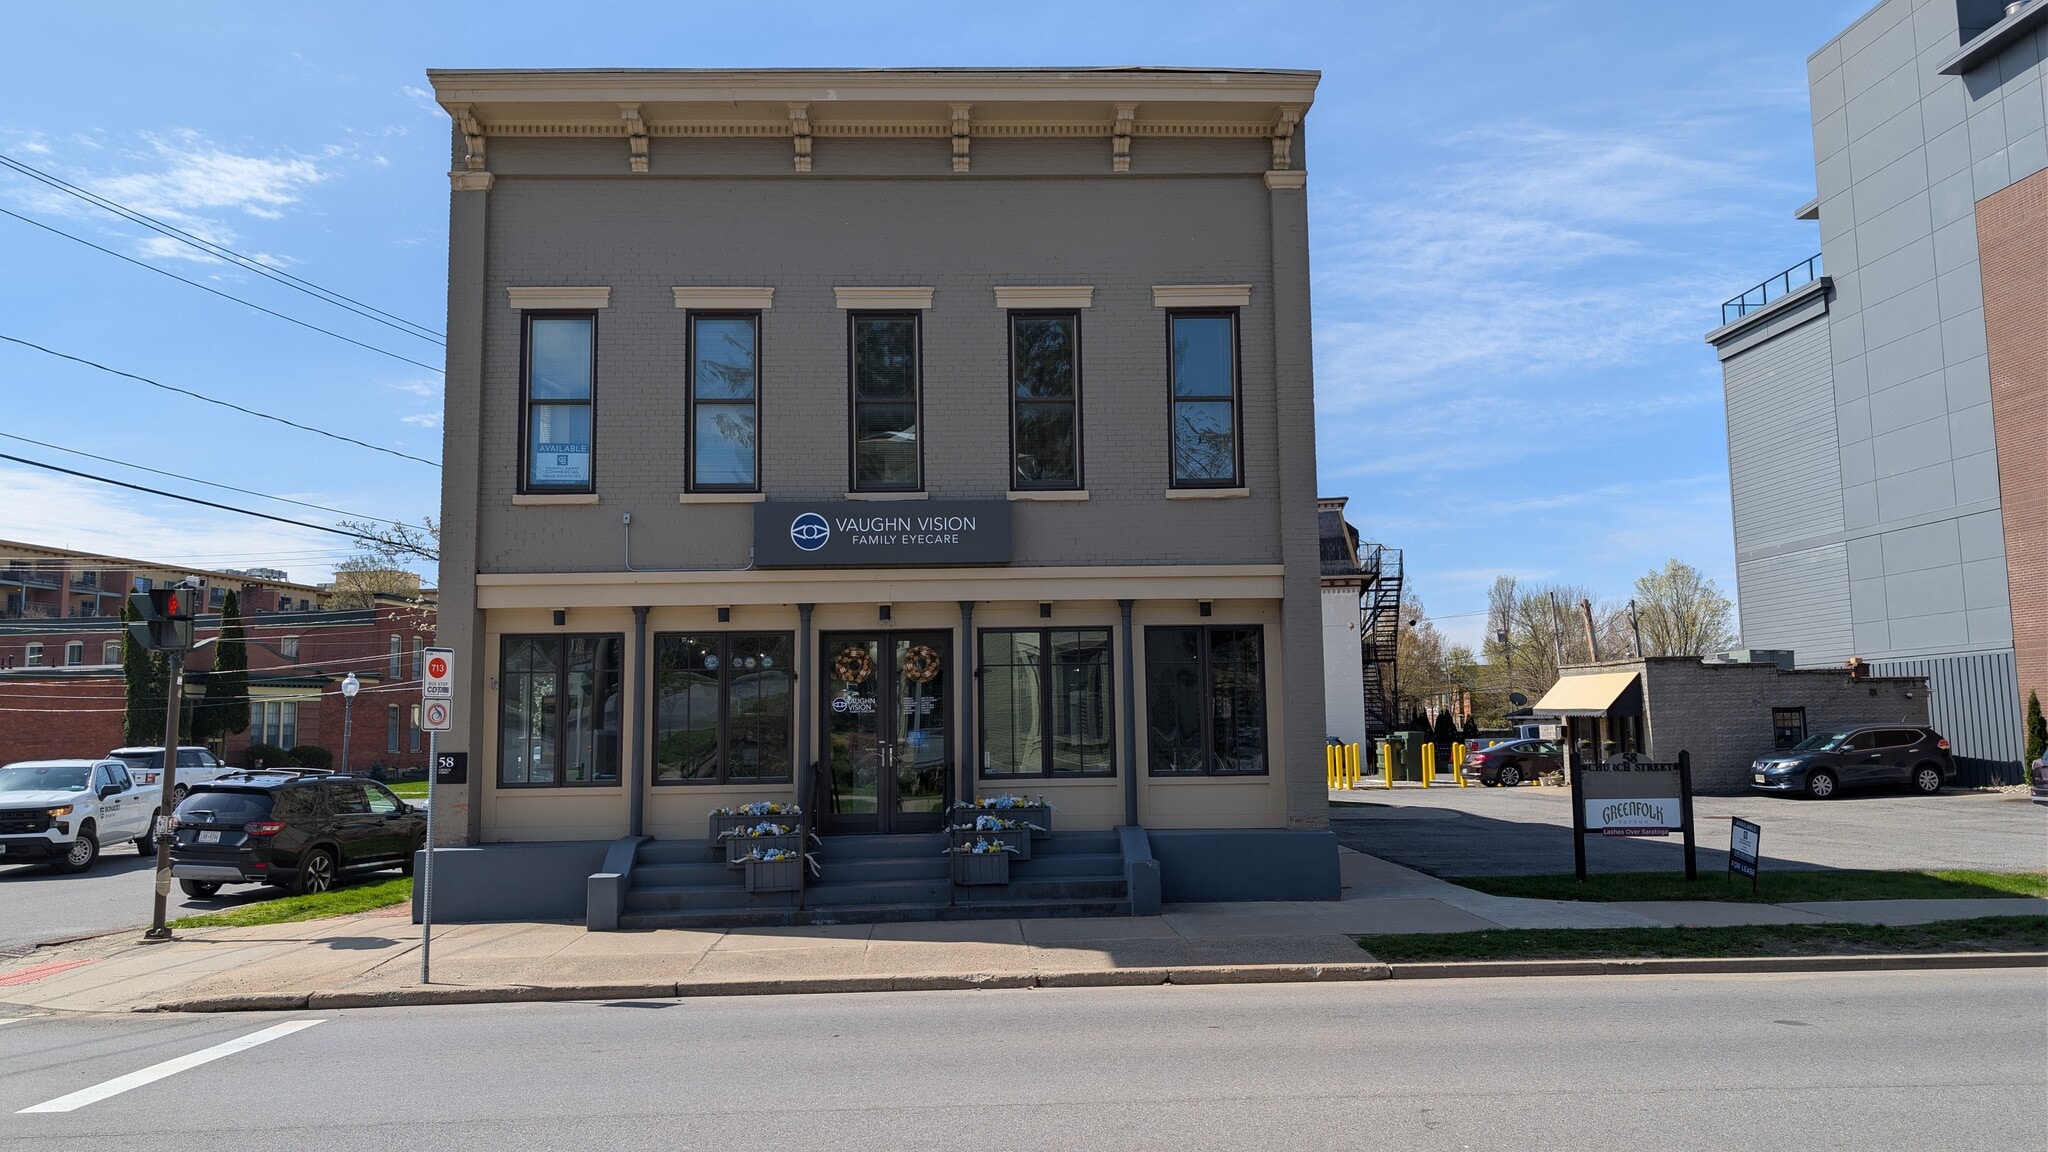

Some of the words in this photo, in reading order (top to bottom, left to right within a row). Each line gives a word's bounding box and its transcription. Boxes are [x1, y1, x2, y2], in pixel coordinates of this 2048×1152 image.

[540, 445, 587, 453] AVAILABLE
[835, 517, 911, 532] VAUGHN
[917, 516, 976, 531] VISION
[852, 534, 897, 545] FAMILY
[902, 533, 959, 544] EYECARE
[431, 664, 445, 672] 713
[438, 756, 454, 768] 58
[1622, 753, 1638, 764] 58
[1588, 763, 1631, 772] CHURCH
[1634, 763, 1673, 772] STREET
[1602, 801, 1664, 825] GREENFOLK
[1641, 828, 1669, 837] Saratoga
[1731, 860, 1741, 870] FOR
[1741, 863, 1756, 877] LEASE
